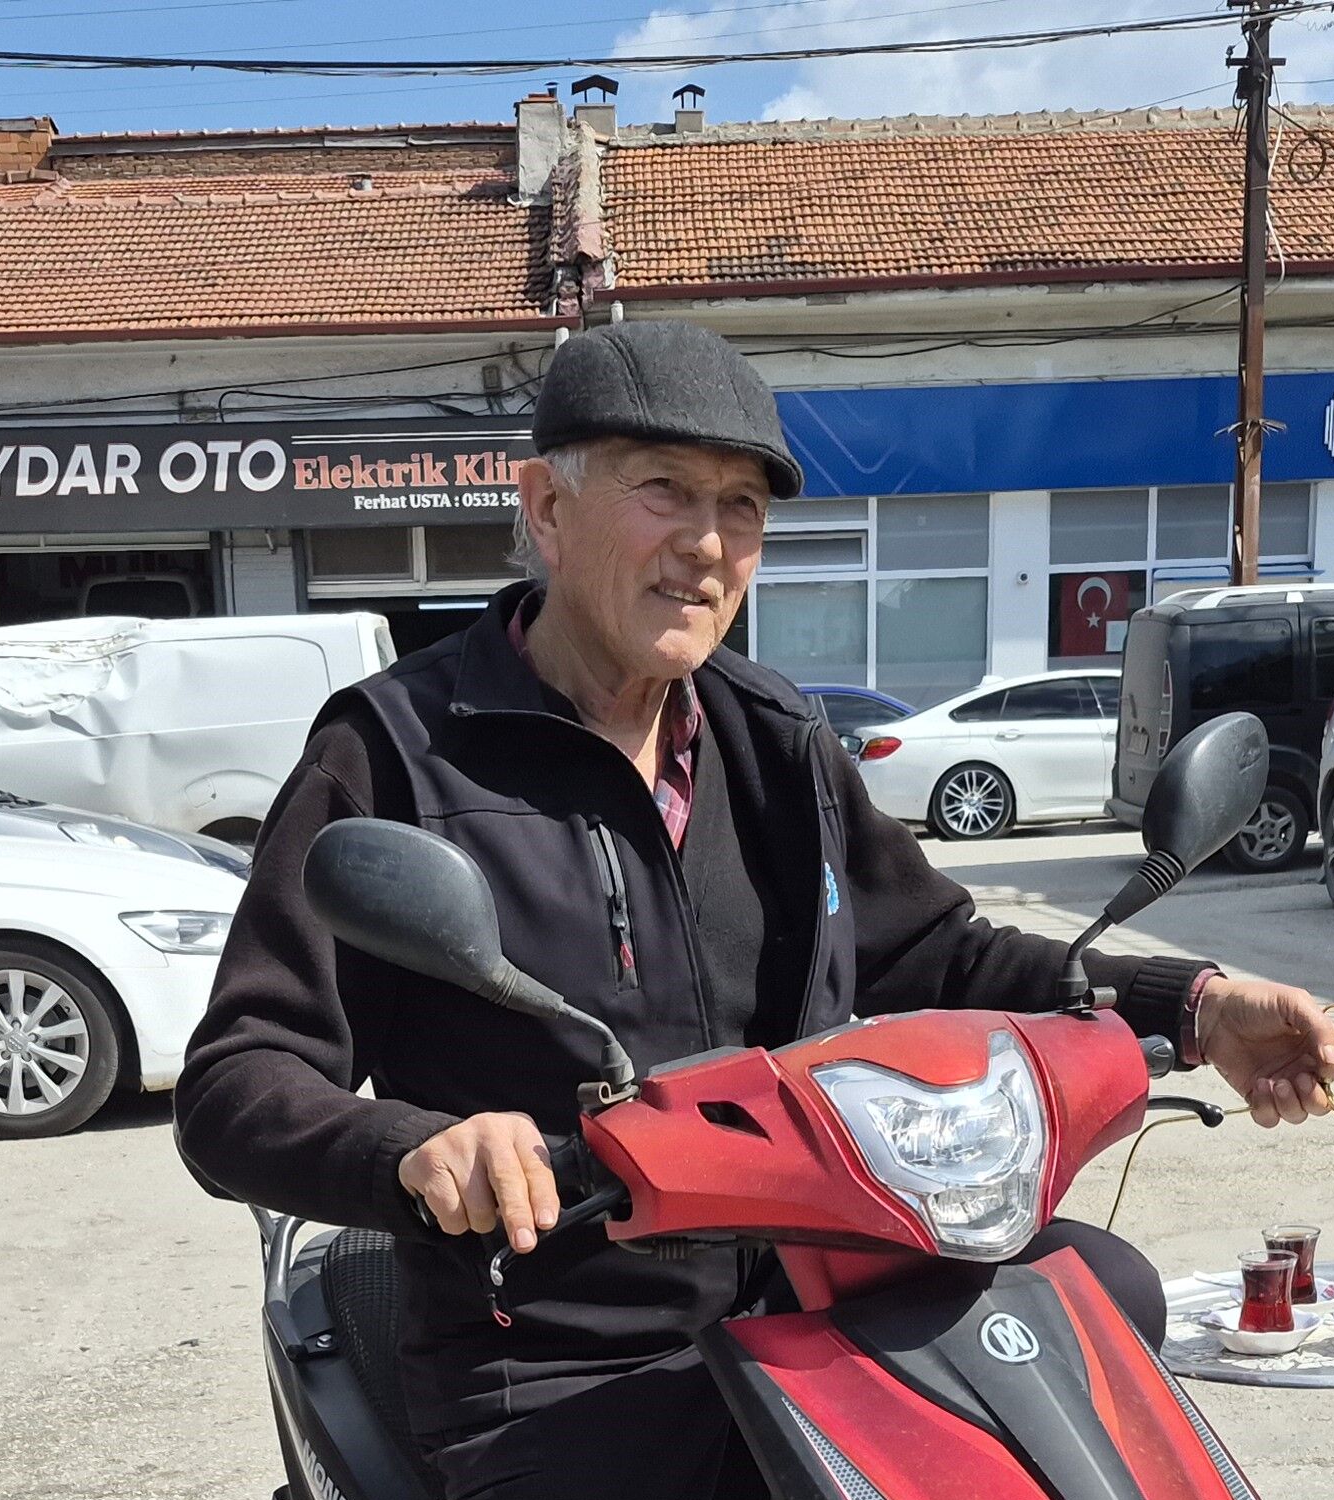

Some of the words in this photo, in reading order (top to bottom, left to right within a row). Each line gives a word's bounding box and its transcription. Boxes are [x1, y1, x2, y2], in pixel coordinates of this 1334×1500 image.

[158, 438, 287, 494] OTO
[292, 453, 449, 490] Elektrik
[354, 493, 408, 510] Ferhat
[410, 492, 451, 508] USTA
[462, 491, 498, 508] 0532
